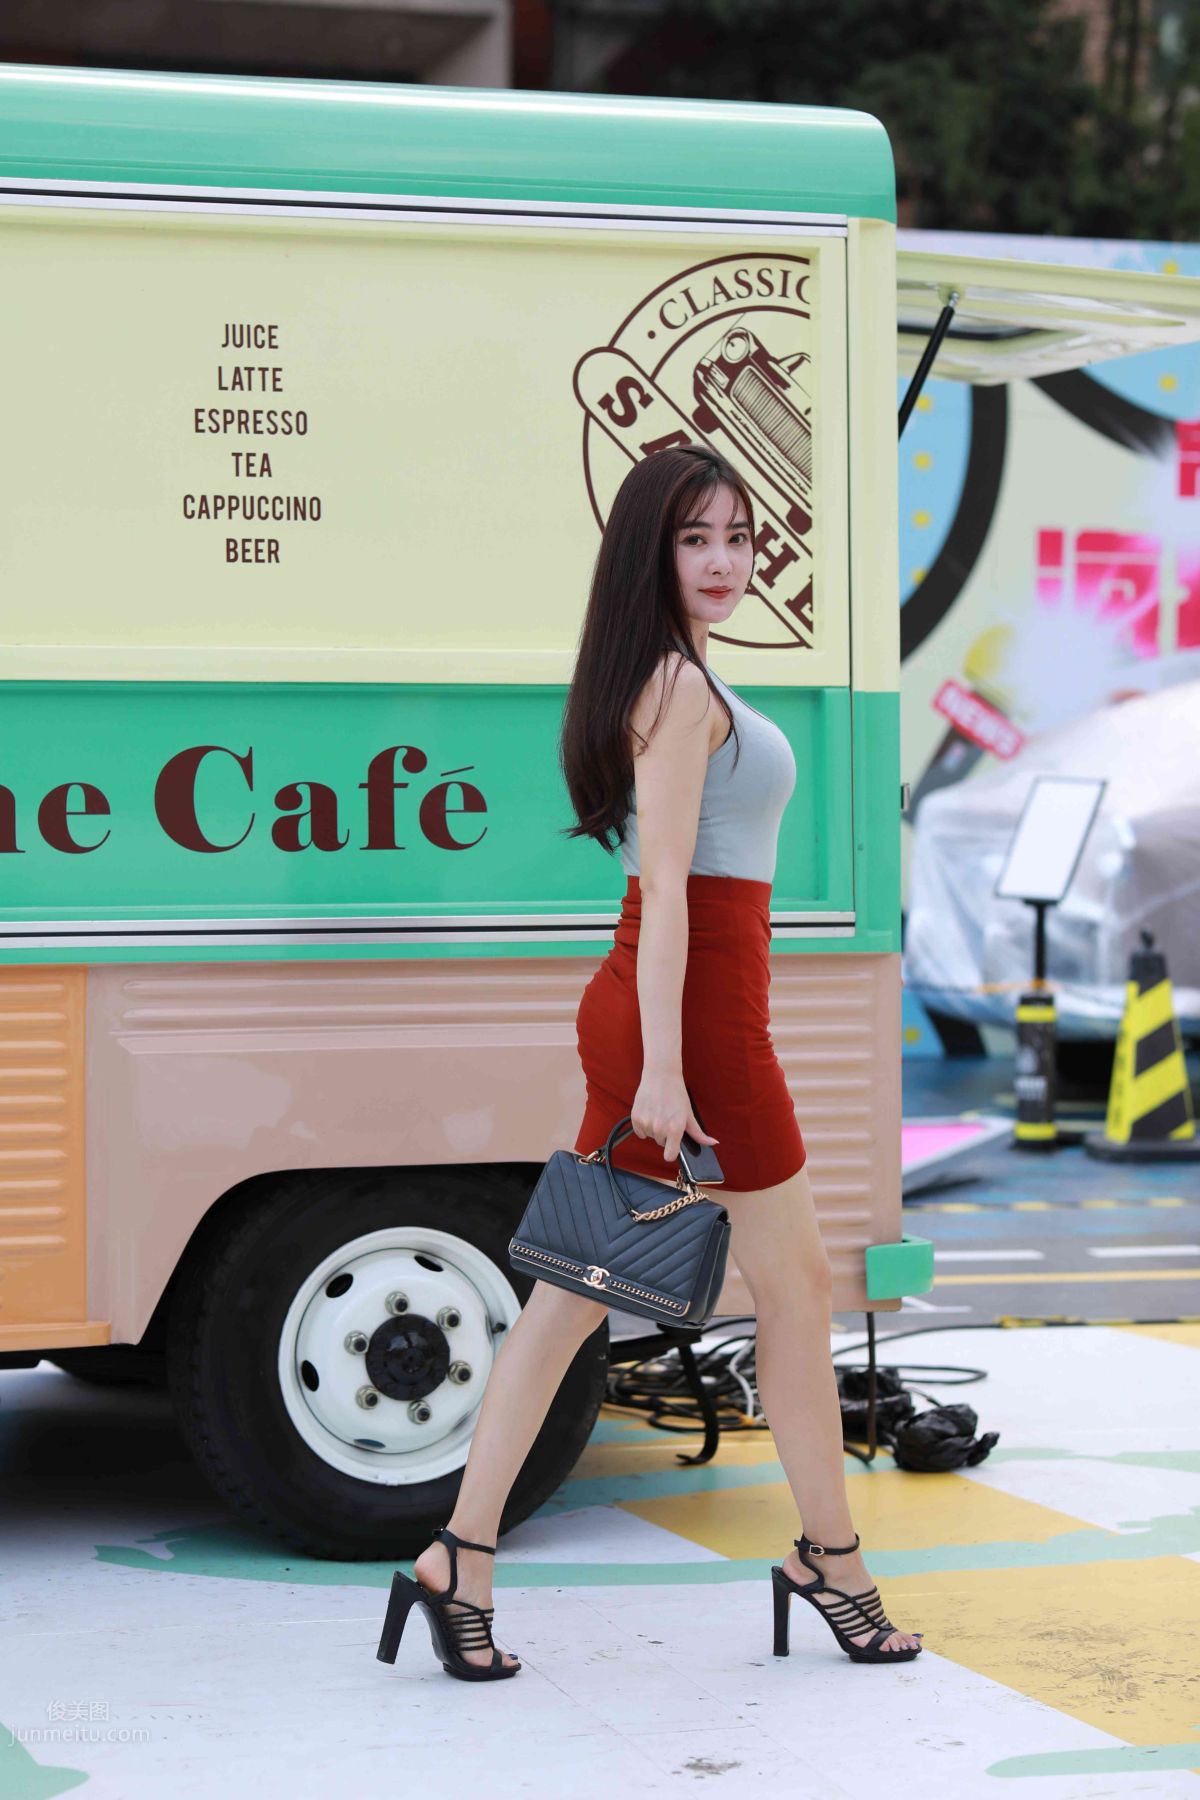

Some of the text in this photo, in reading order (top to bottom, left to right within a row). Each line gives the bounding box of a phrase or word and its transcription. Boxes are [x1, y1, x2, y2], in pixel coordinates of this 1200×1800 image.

[221, 323, 279, 350] JUICE
[218, 365, 283, 393] LATTE
[194, 408, 308, 436] ESPRESSO
[231, 452, 273, 478] TEA
[183, 494, 322, 522] CAPPUCCINO
[225, 538, 280, 564] BEER
[154, 745, 488, 853] Café
